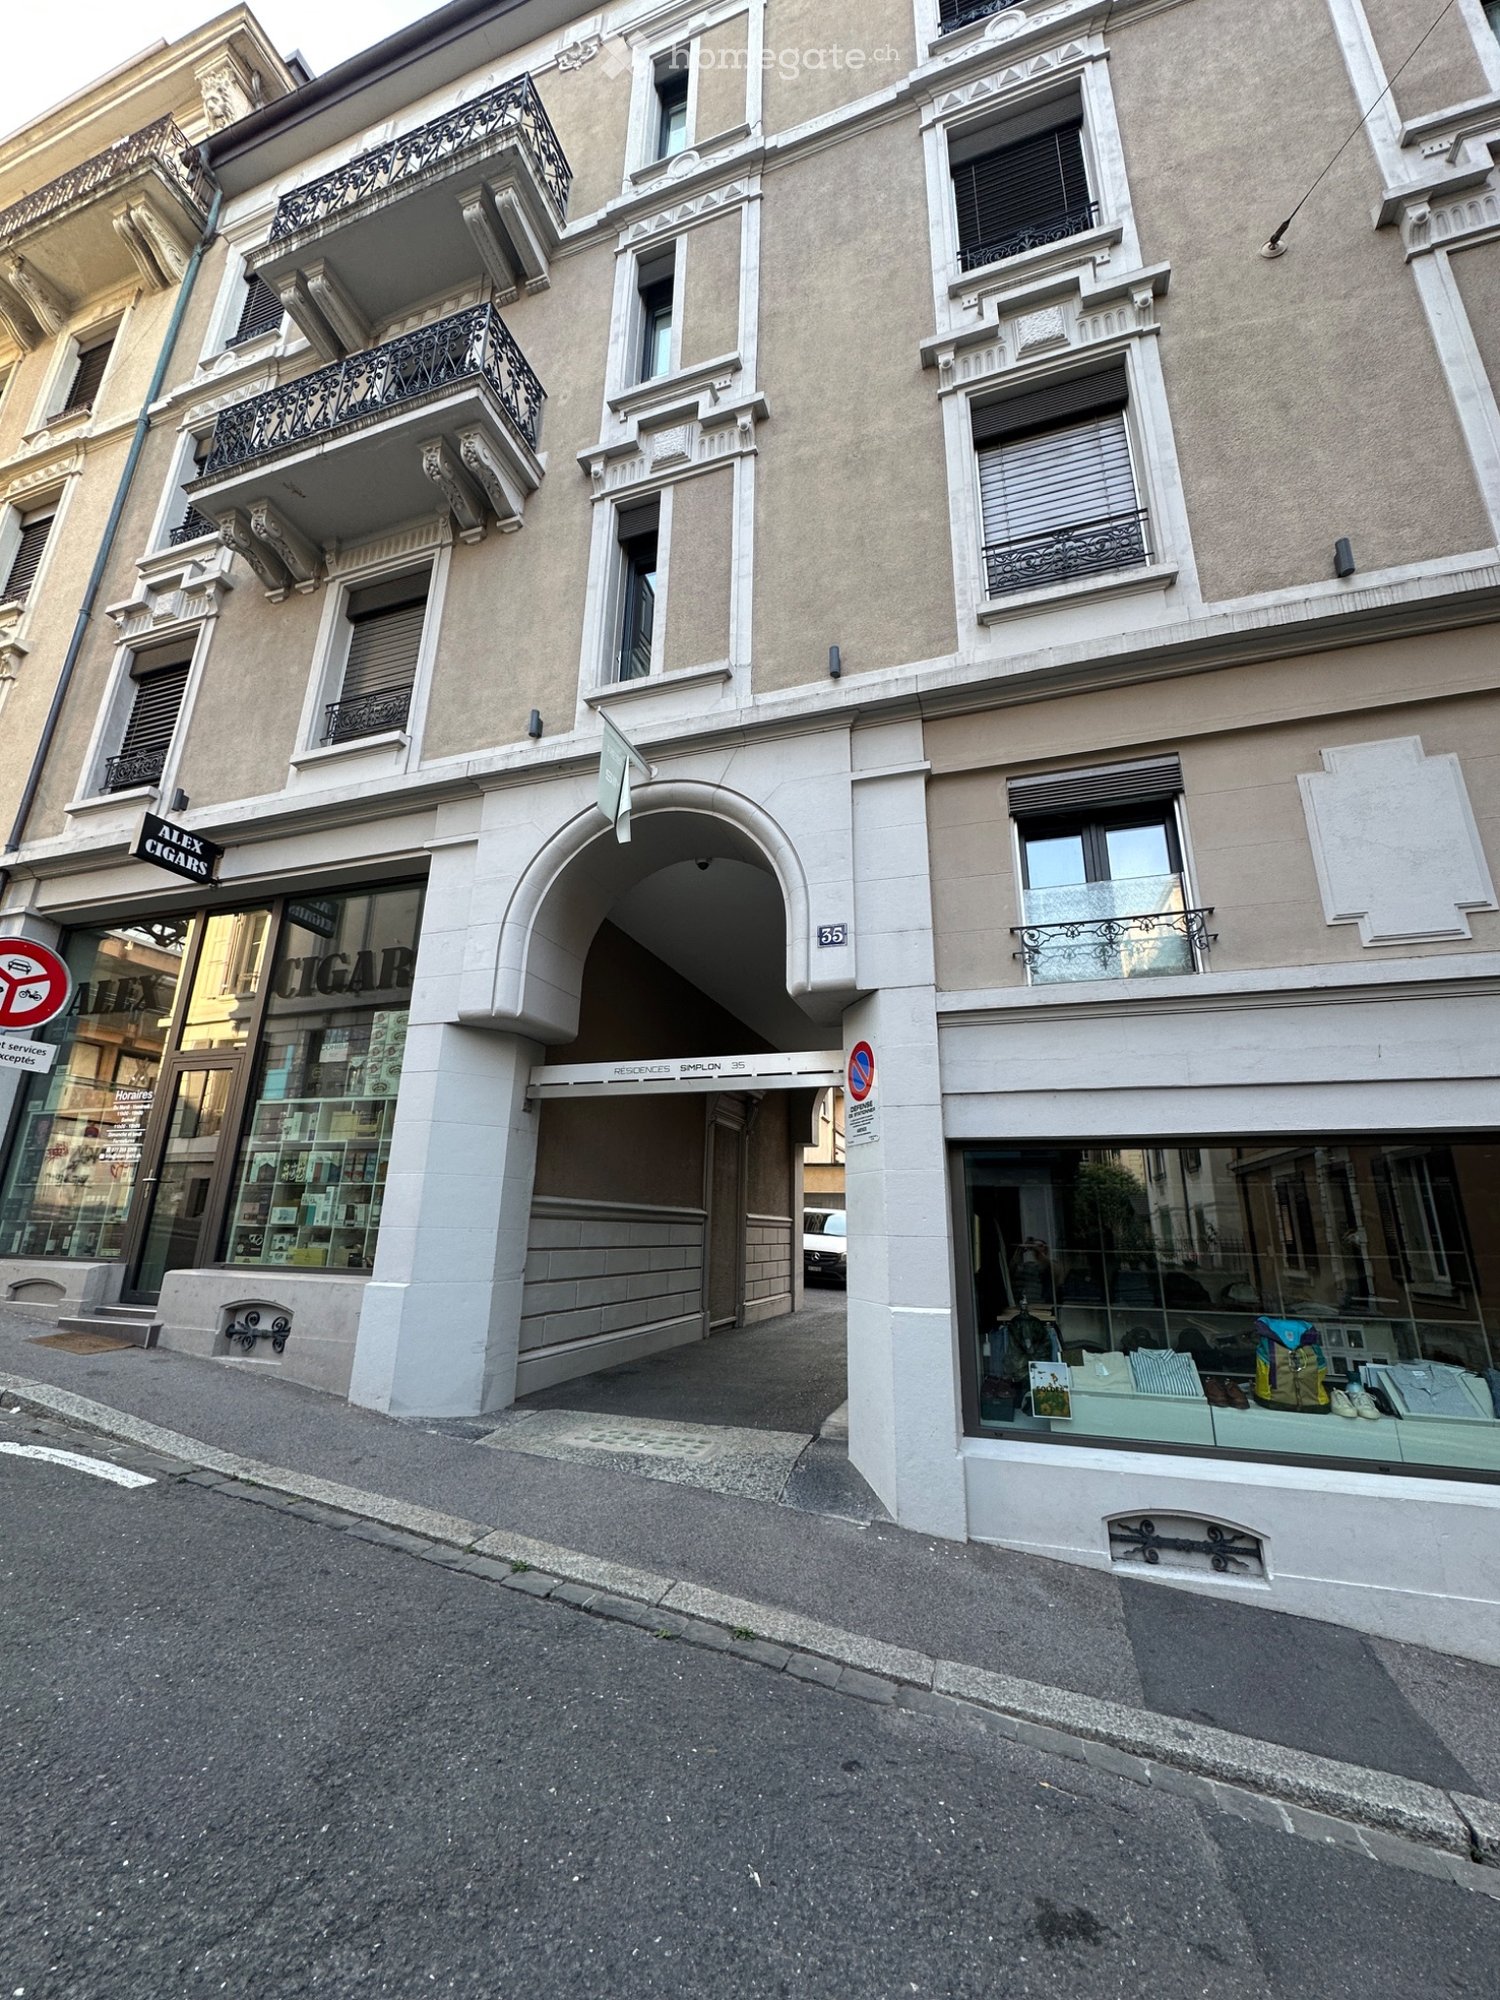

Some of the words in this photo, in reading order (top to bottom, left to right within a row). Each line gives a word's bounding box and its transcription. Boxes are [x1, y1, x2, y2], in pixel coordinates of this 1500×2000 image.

[158, 824, 204, 855] ALEX
[145, 838, 208, 876] CIGARS
[821, 926, 844, 944] 35
[66, 975, 159, 1016] ALEX
[8, 1043, 48, 1057] services
[679, 1062, 722, 1073] SIMPLON
[731, 1061, 746, 1071] 35
[115, 1089, 153, 1100] Horaires
